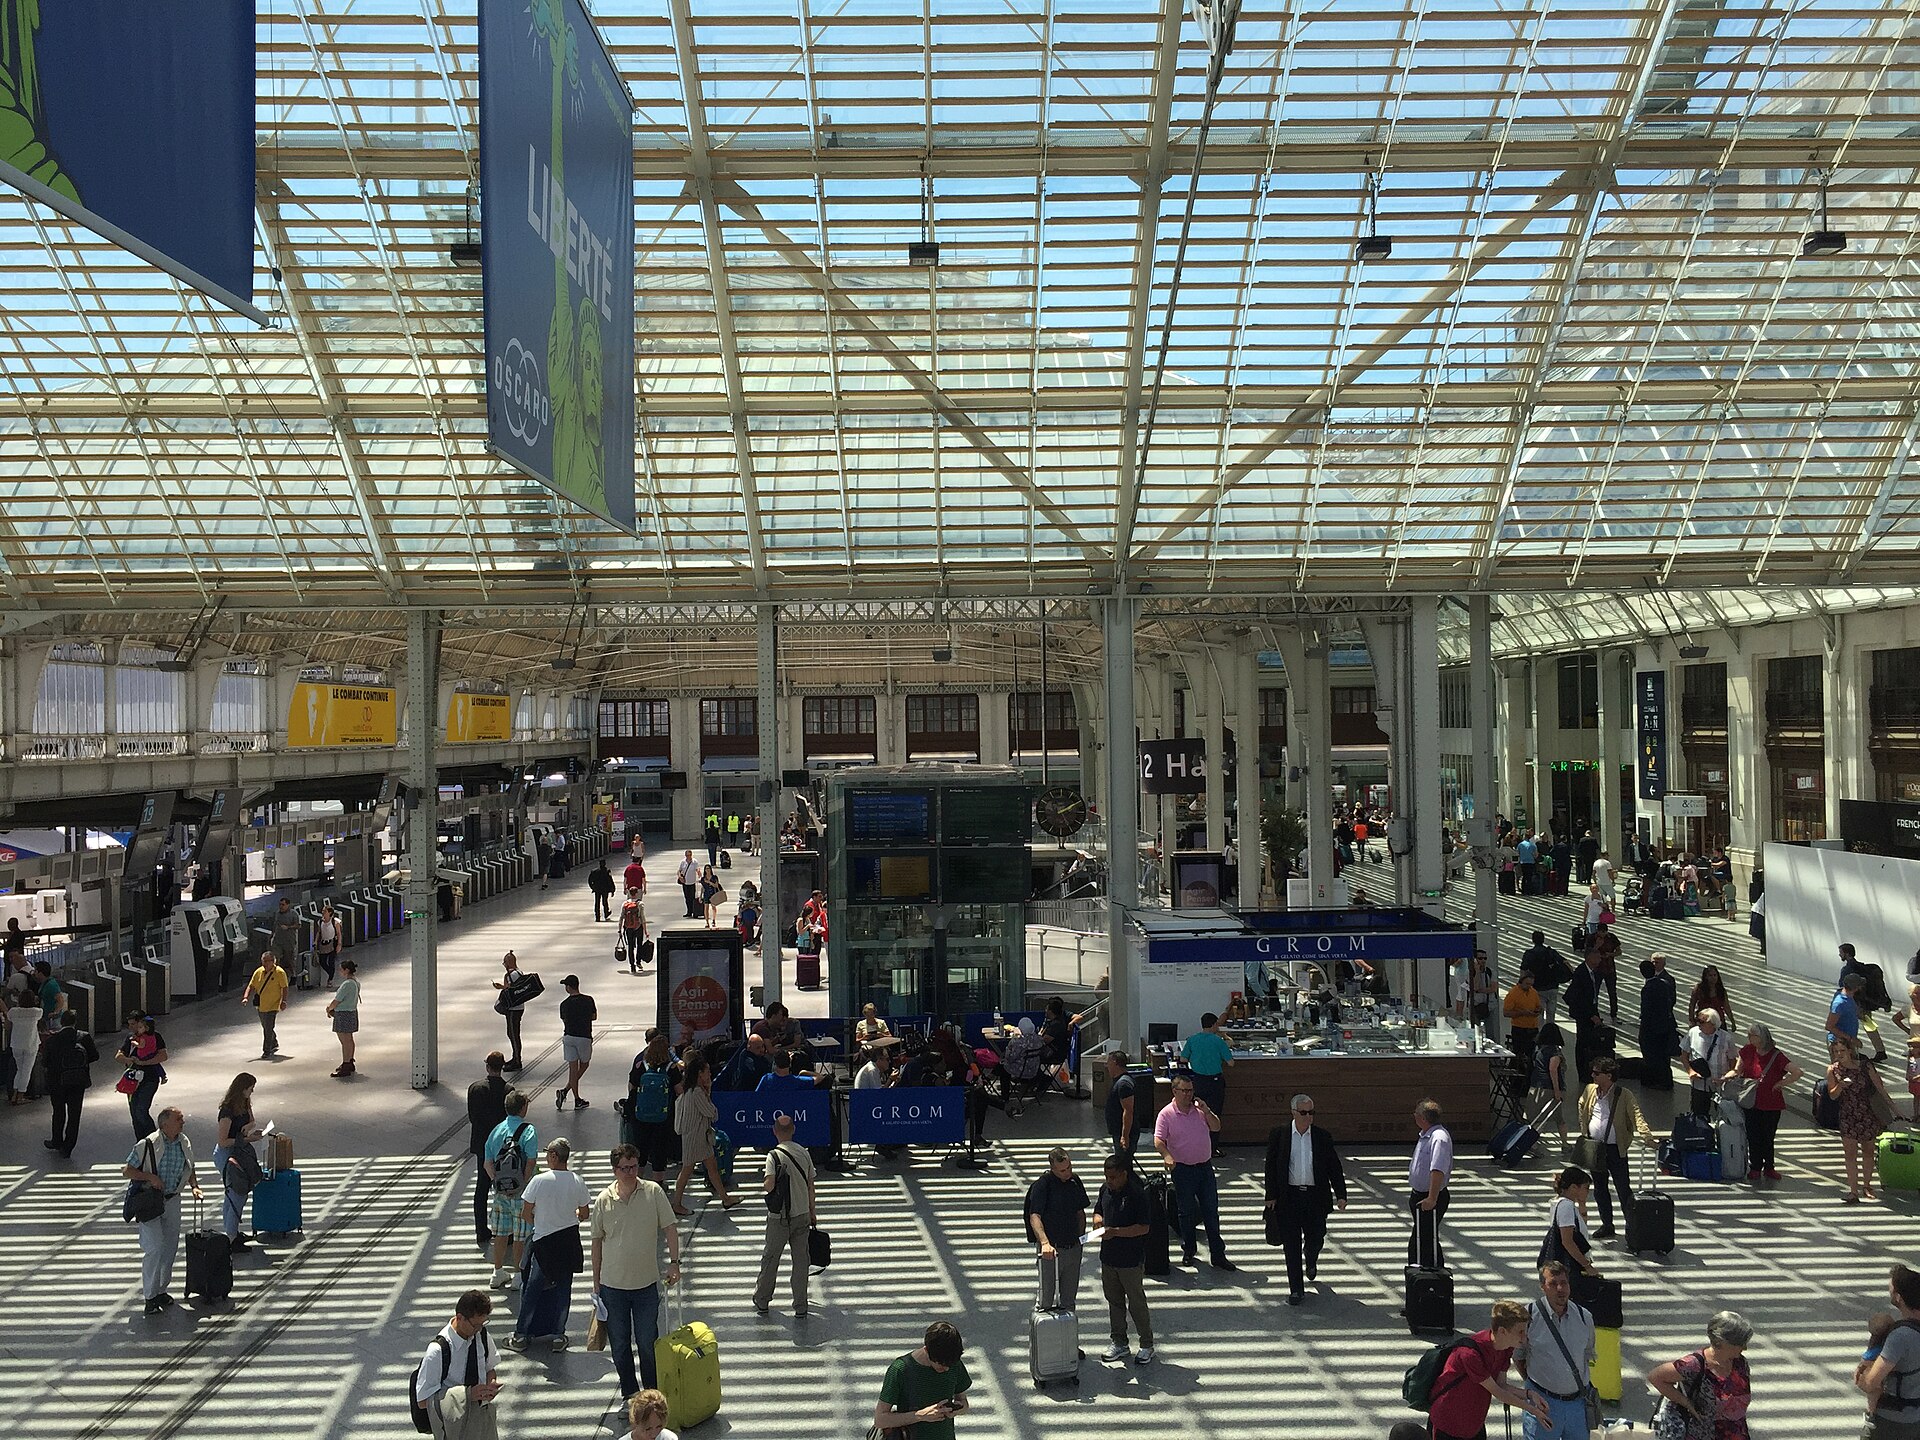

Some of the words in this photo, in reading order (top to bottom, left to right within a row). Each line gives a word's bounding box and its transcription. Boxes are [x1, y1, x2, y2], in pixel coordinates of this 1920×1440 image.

[527, 143, 613, 323] LIBERTÉ
[494, 355, 549, 427] OSCARO
[332, 688, 339, 699] LE
[339, 688, 363, 700] COMBAT
[363, 690, 389, 702] CONTINUE
[143, 806, 154, 822] 19
[214, 799, 225, 815] 17
[1256, 935, 1366, 953] GROM
[679, 987, 708, 999] Agir
[678, 999, 724, 1010] Penser
[1244, 1092, 1285, 1103] GRO
[735, 1109, 808, 1123] GROM
[871, 1105, 944, 1119] GROM
